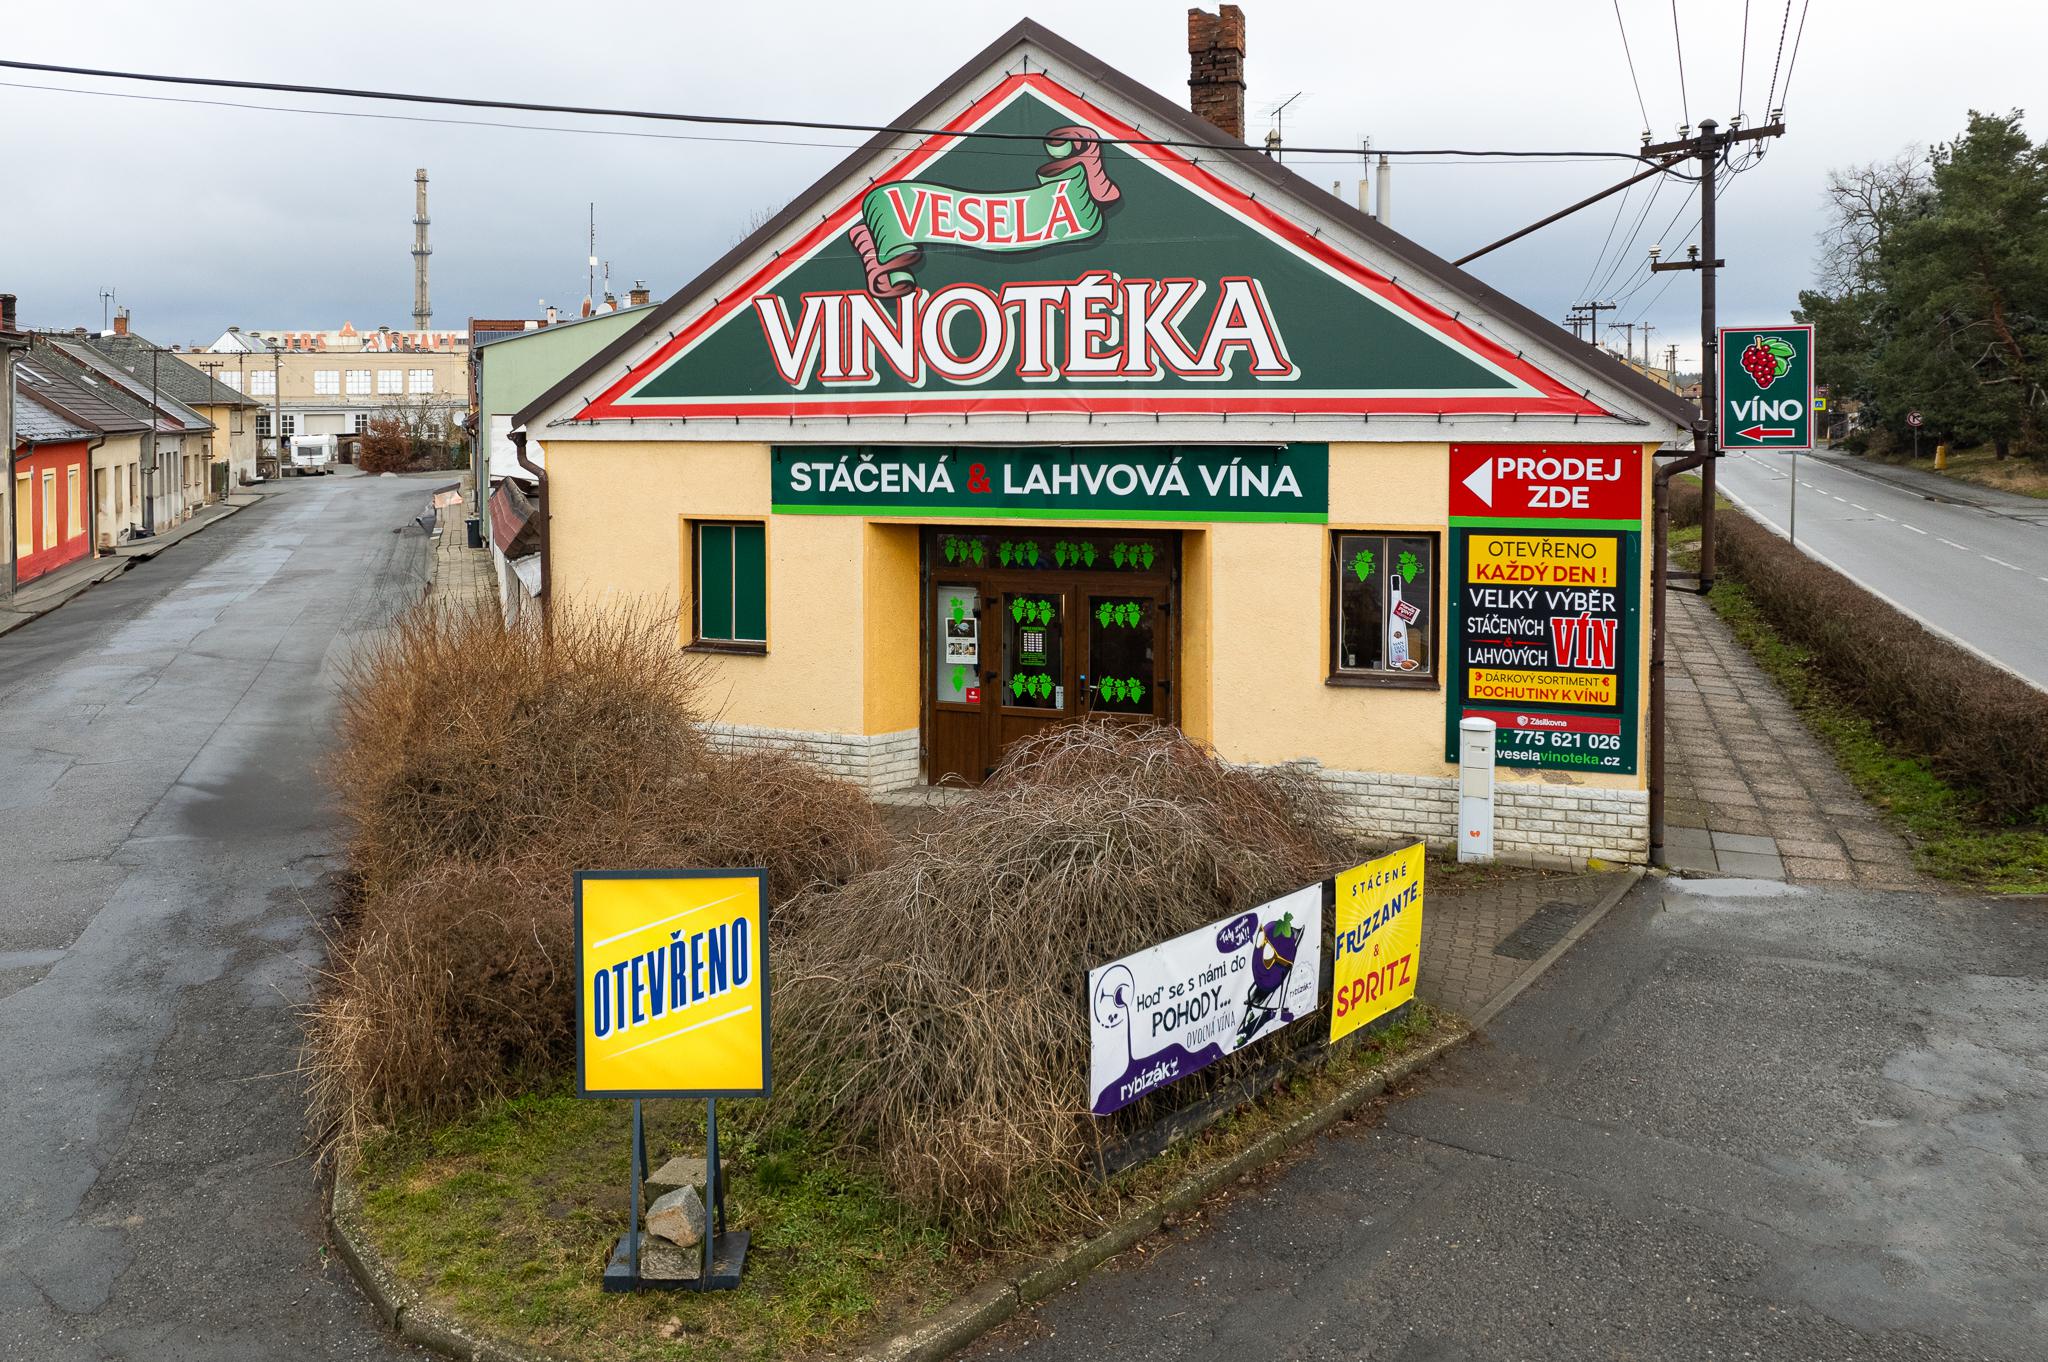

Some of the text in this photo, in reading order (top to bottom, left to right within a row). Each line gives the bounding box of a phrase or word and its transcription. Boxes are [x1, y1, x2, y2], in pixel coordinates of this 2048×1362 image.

[884, 180, 1087, 248] VESELÁ
[284, 333, 328, 350] TOS
[753, 269, 1302, 390] VINOTÉKA
[1731, 395, 1804, 422] VÍNO
[790, 453, 1304, 499] STÁČENÁ & LAHVOVÁ VÍNA
[1497, 456, 1623, 482] PRODEJ
[1527, 485, 1591, 509] ZDE
[1488, 538, 1598, 561] OTEVŘENO
[1476, 560, 1608, 584] KAŽDÝ DEN !
[1469, 586, 1617, 612] VELKÝ VÝBĚR
[1467, 613, 1544, 637] STÁČENÝCH
[1549, 610, 1618, 670] VÍN
[1468, 642, 1548, 667] LAHVOVÝCH
[1485, 671, 1600, 687] DÁRKOVÝ SORTIMENT
[1473, 684, 1610, 704] POCHUTINY K VÍNU
[1530, 717, 1568, 728] Zásilkovna
[1513, 730, 1545, 746] 775
[1551, 732, 1582, 748] 621
[1588, 734, 1621, 750] 026
[1351, 861, 1407, 897] STÁČENÉ
[1335, 879, 1418, 962] FRIZZANTE
[1373, 944, 1380, 957] &
[593, 917, 751, 1041] OTEVŘENO
[1168, 983, 1185, 999] se
[1188, 977, 1195, 991] s
[1198, 962, 1227, 986] námi
[1230, 955, 1246, 974] do
[1336, 952, 1412, 1018] SPRITZ
[1186, 1010, 1236, 1048] OVOCNÁ VÍNA
